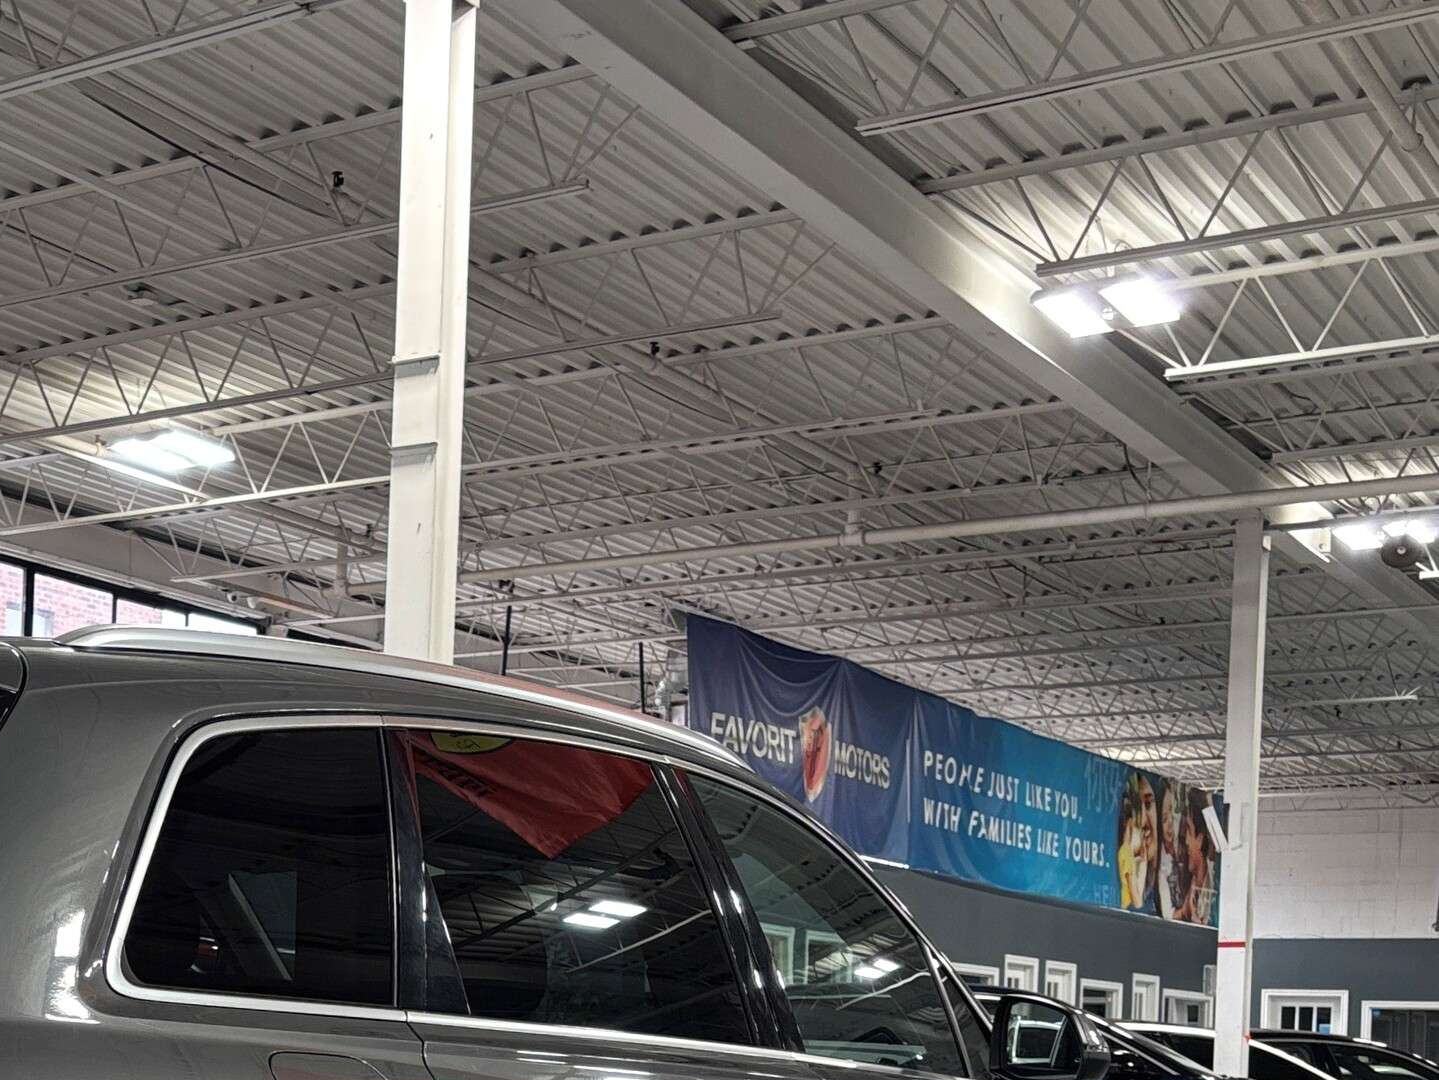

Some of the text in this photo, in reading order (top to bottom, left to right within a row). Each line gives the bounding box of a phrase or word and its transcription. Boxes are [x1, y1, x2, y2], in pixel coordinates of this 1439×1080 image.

[711, 712, 890, 789] FAVORIT MOTORS
[987, 772, 1020, 803] JUST
[1025, 782, 1051, 812] LIKE
[923, 797, 961, 832] WITH
[968, 811, 1032, 850] FAMILIES
[1037, 828, 1059, 858] LIKE
